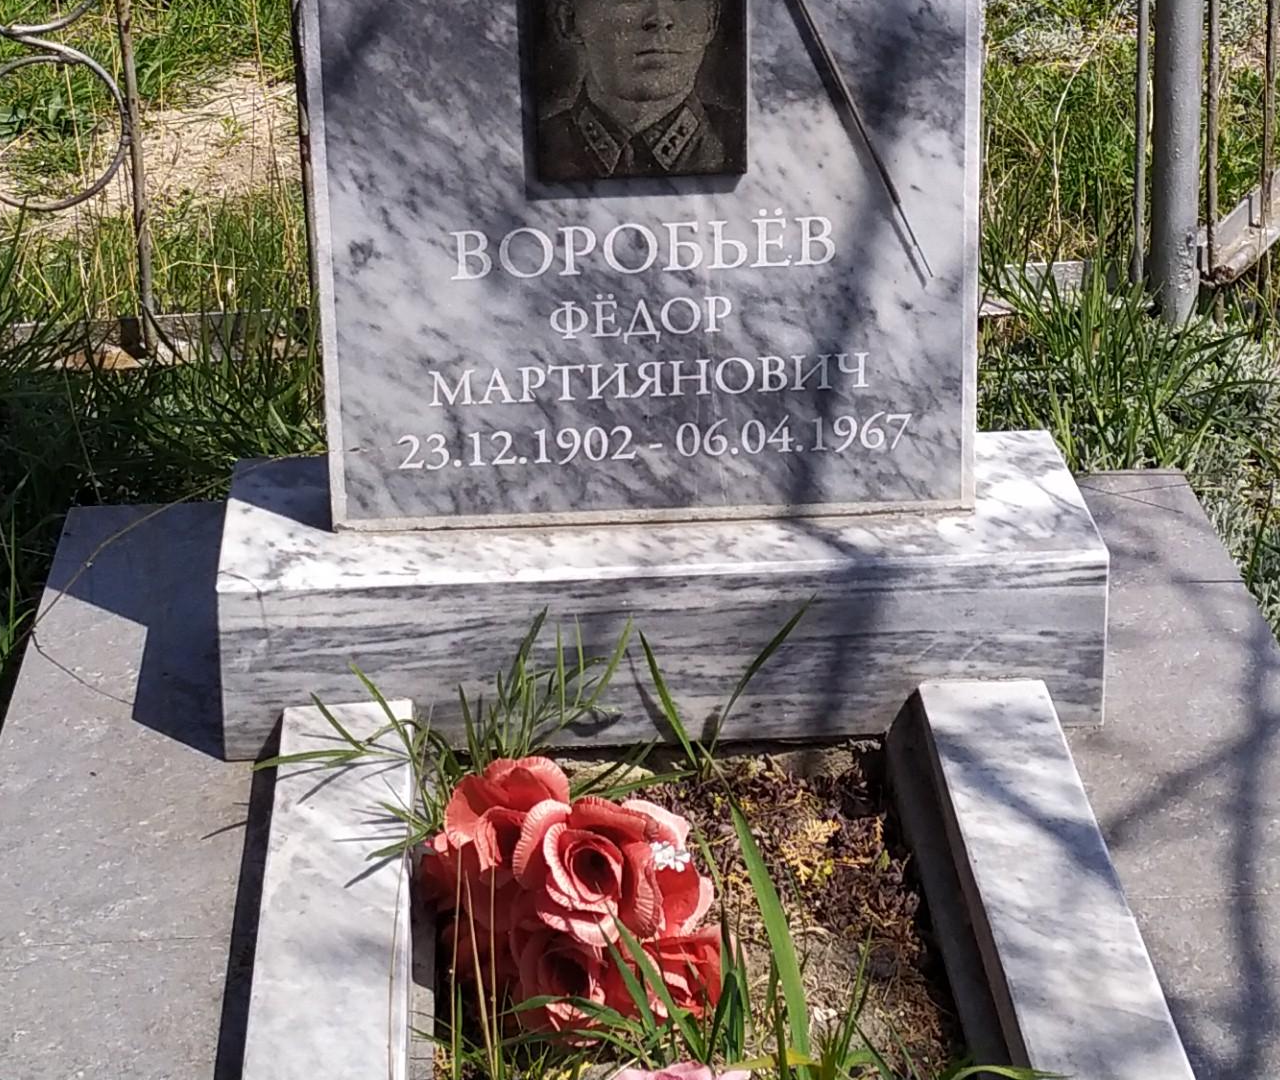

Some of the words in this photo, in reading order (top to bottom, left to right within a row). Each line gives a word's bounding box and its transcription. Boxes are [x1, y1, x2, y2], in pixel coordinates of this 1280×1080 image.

[449, 208, 837, 281] ВОРОБЬЁВ
[549, 292, 733, 344] ФЁДОР
[427, 351, 870, 408] МАРТИЯНОВИЧ
[396, 427, 637, 471] 23.12.1902
[675, 411, 912, 458] 06.04.1967
